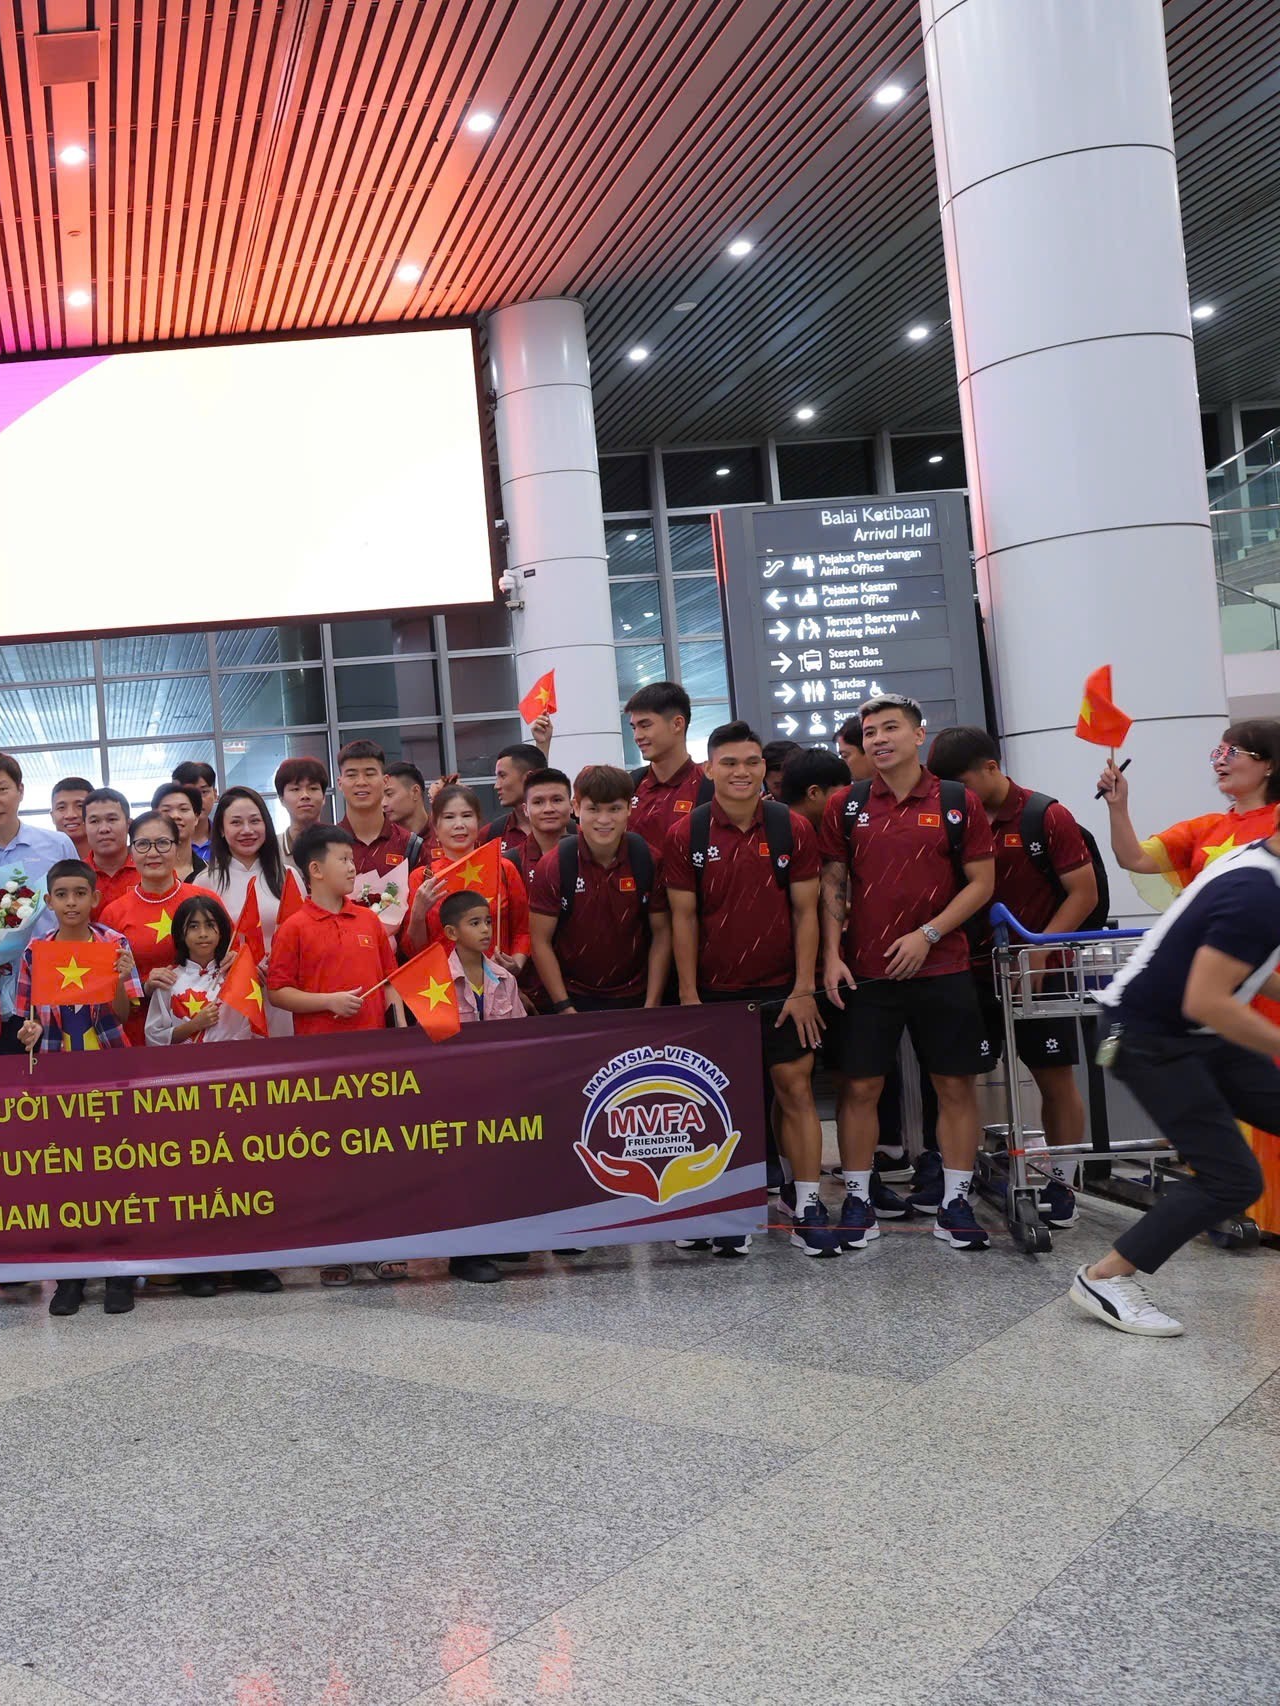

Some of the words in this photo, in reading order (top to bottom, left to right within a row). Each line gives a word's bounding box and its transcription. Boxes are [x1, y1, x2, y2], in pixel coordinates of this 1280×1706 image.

[821, 509, 857, 525] Balai
[862, 506, 930, 523] Ketibaan
[854, 526, 897, 542] Arrival
[902, 523, 931, 538] Hall
[818, 554, 855, 566] Pejabat
[858, 550, 921, 562] Penerbangan
[820, 565, 849, 576] Airline
[851, 563, 884, 575] Offices
[821, 585, 858, 597] Pejabat
[860, 582, 897, 593] Kastam
[823, 597, 858, 607] Custom
[860, 594, 889, 606] Office
[824, 615, 862, 628] Tempat
[864, 612, 909, 624] Bertemu
[910, 610, 920, 620] A
[825, 627, 863, 639] Meeting
[864, 624, 886, 635] Point
[888, 624, 896, 634] A
[828, 648, 860, 659] Stesen
[862, 646, 879, 656] Bas
[829, 660, 846, 670] Bus
[848, 657, 883, 669] Stations
[830, 678, 866, 689] Tandas
[831, 690, 861, 701] Toilets
[585, 1048, 653, 1096] MALAYSIA
[666, 1047, 727, 1089] VIETNAM
[57, 1089, 123, 1123] VIỆT
[133, 1085, 200, 1114] NAM
[209, 1081, 257, 1113] TẠI
[267, 1070, 422, 1105] MALAYSIA
[610, 1104, 704, 1136] MVFA
[93, 1137, 181, 1171] BÓNG
[189, 1131, 234, 1165] ĐÁ
[242, 1126, 331, 1163] QUỐC
[340, 1126, 395, 1156] GIA
[400, 1120, 468, 1155] VIỆT
[477, 1114, 543, 1145] NAM
[628, 1135, 688, 1146] FRIENDSHIP
[625, 1145, 692, 1158] ASSOCIATION
[59, 1192, 161, 1229] QUYẾT
[168, 1186, 275, 1221] THẮNG
